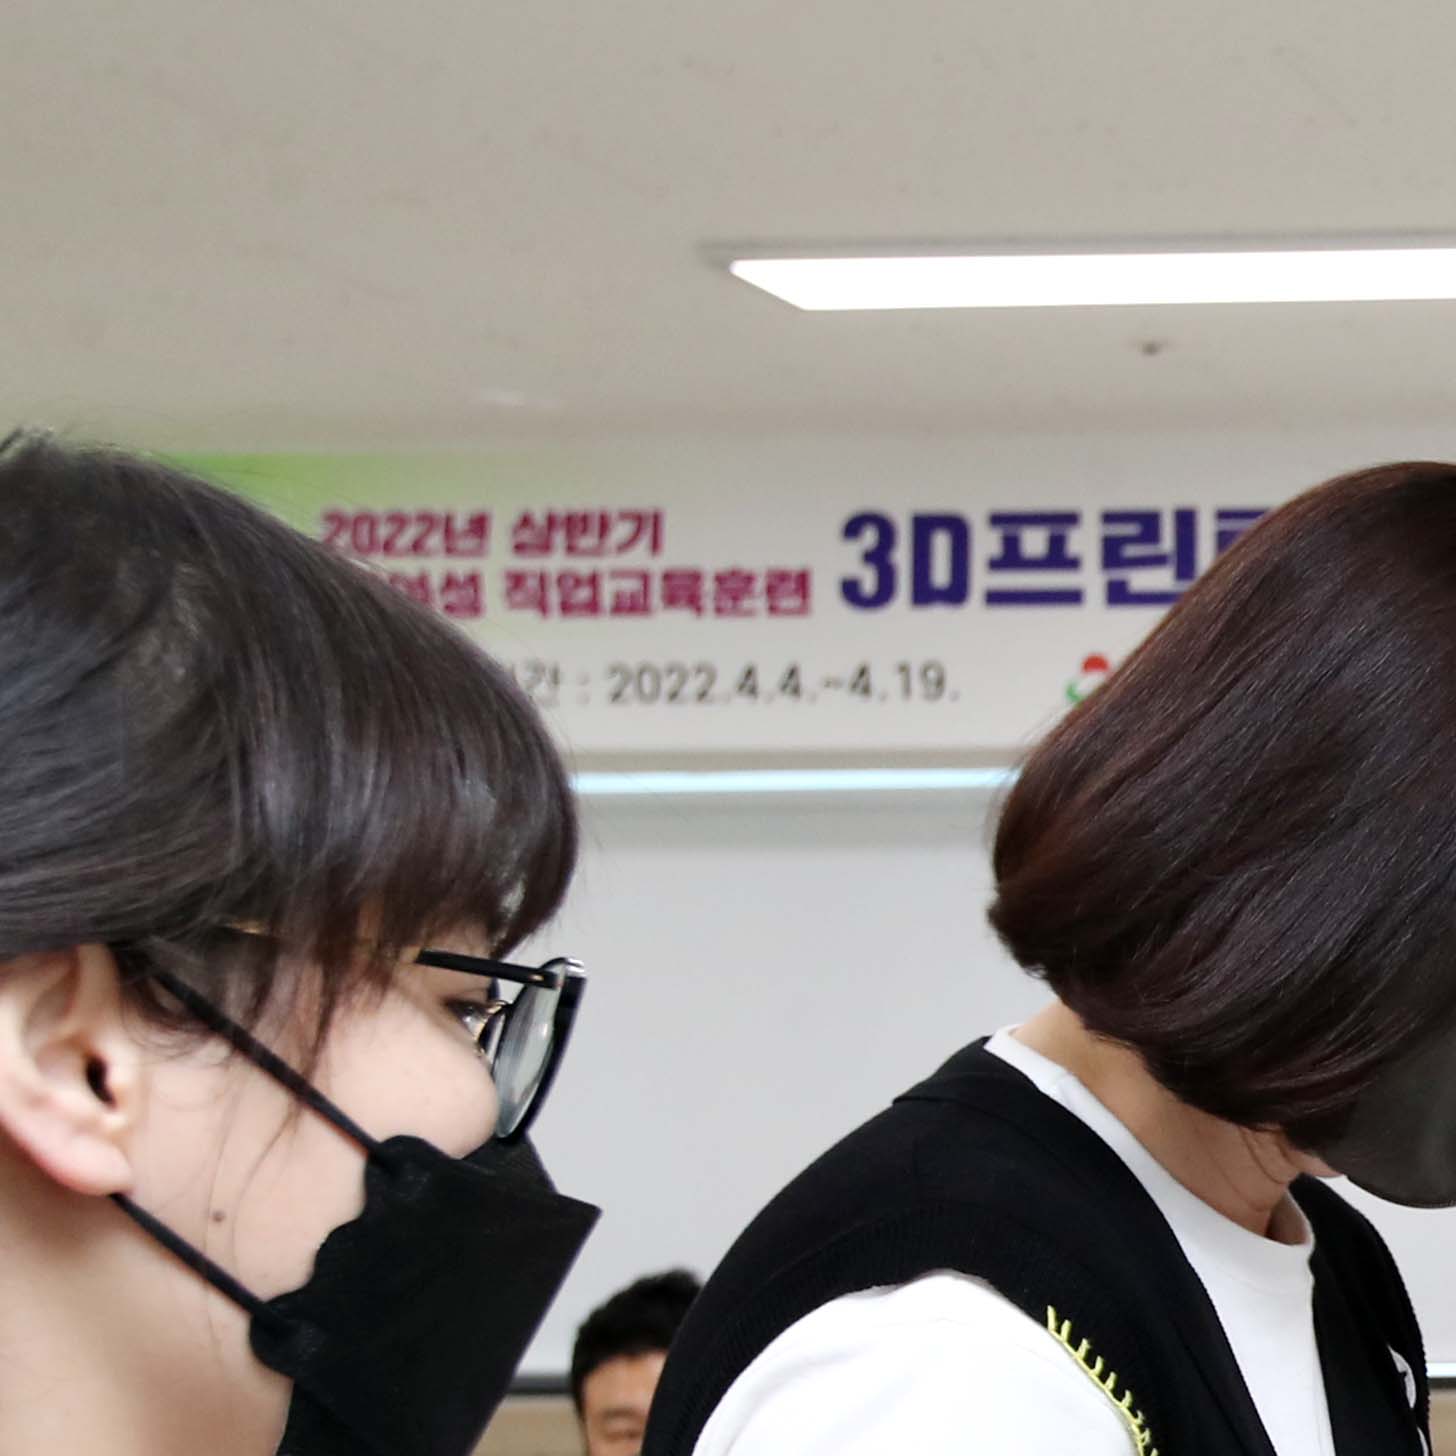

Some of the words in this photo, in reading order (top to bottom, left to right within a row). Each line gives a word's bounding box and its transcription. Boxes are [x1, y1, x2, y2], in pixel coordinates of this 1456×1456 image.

[324, 509, 490, 557] 2022년
[512, 509, 663, 557] 상반기
[385, 566, 484, 619] 여성
[504, 566, 812, 620] 직업교육훈련
